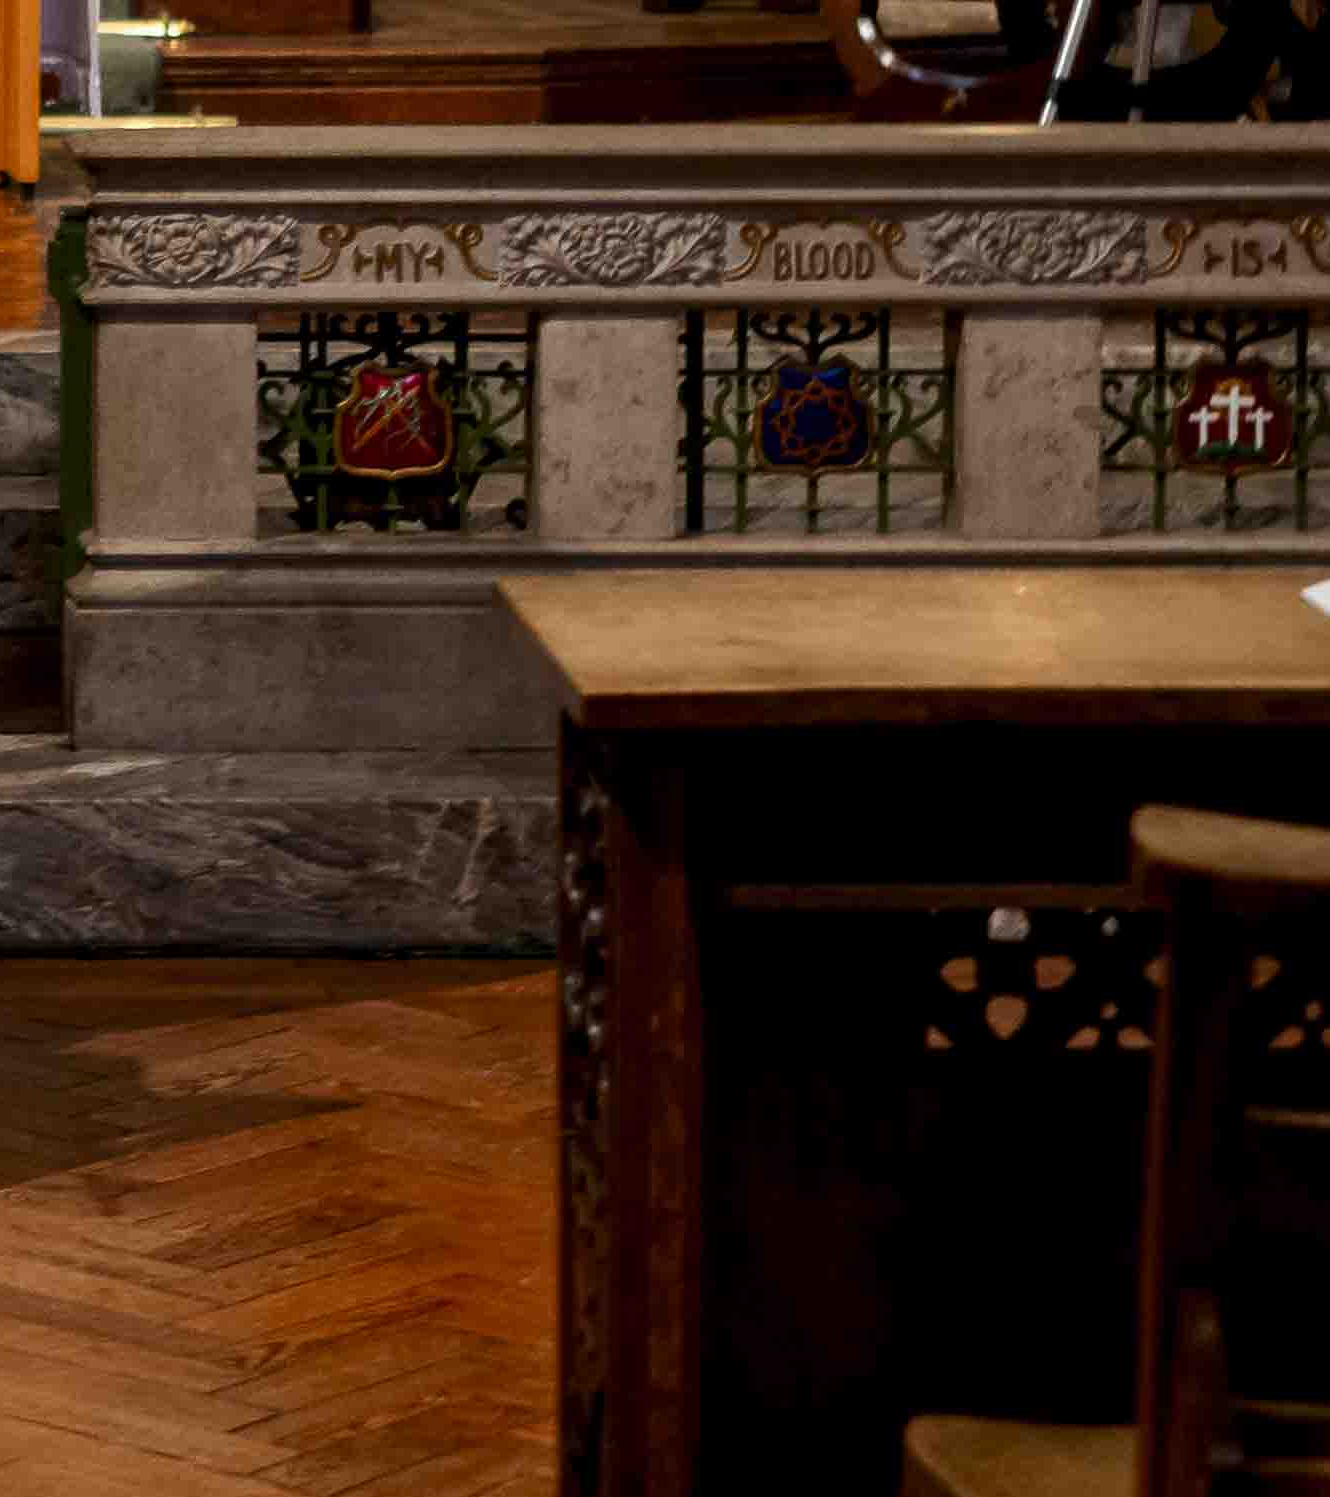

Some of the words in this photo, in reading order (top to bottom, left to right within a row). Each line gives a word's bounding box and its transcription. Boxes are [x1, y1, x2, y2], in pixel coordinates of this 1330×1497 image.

[375, 241, 430, 283] MY
[774, 241, 875, 281] BLOOD
[1232, 238, 1264, 278] IS
